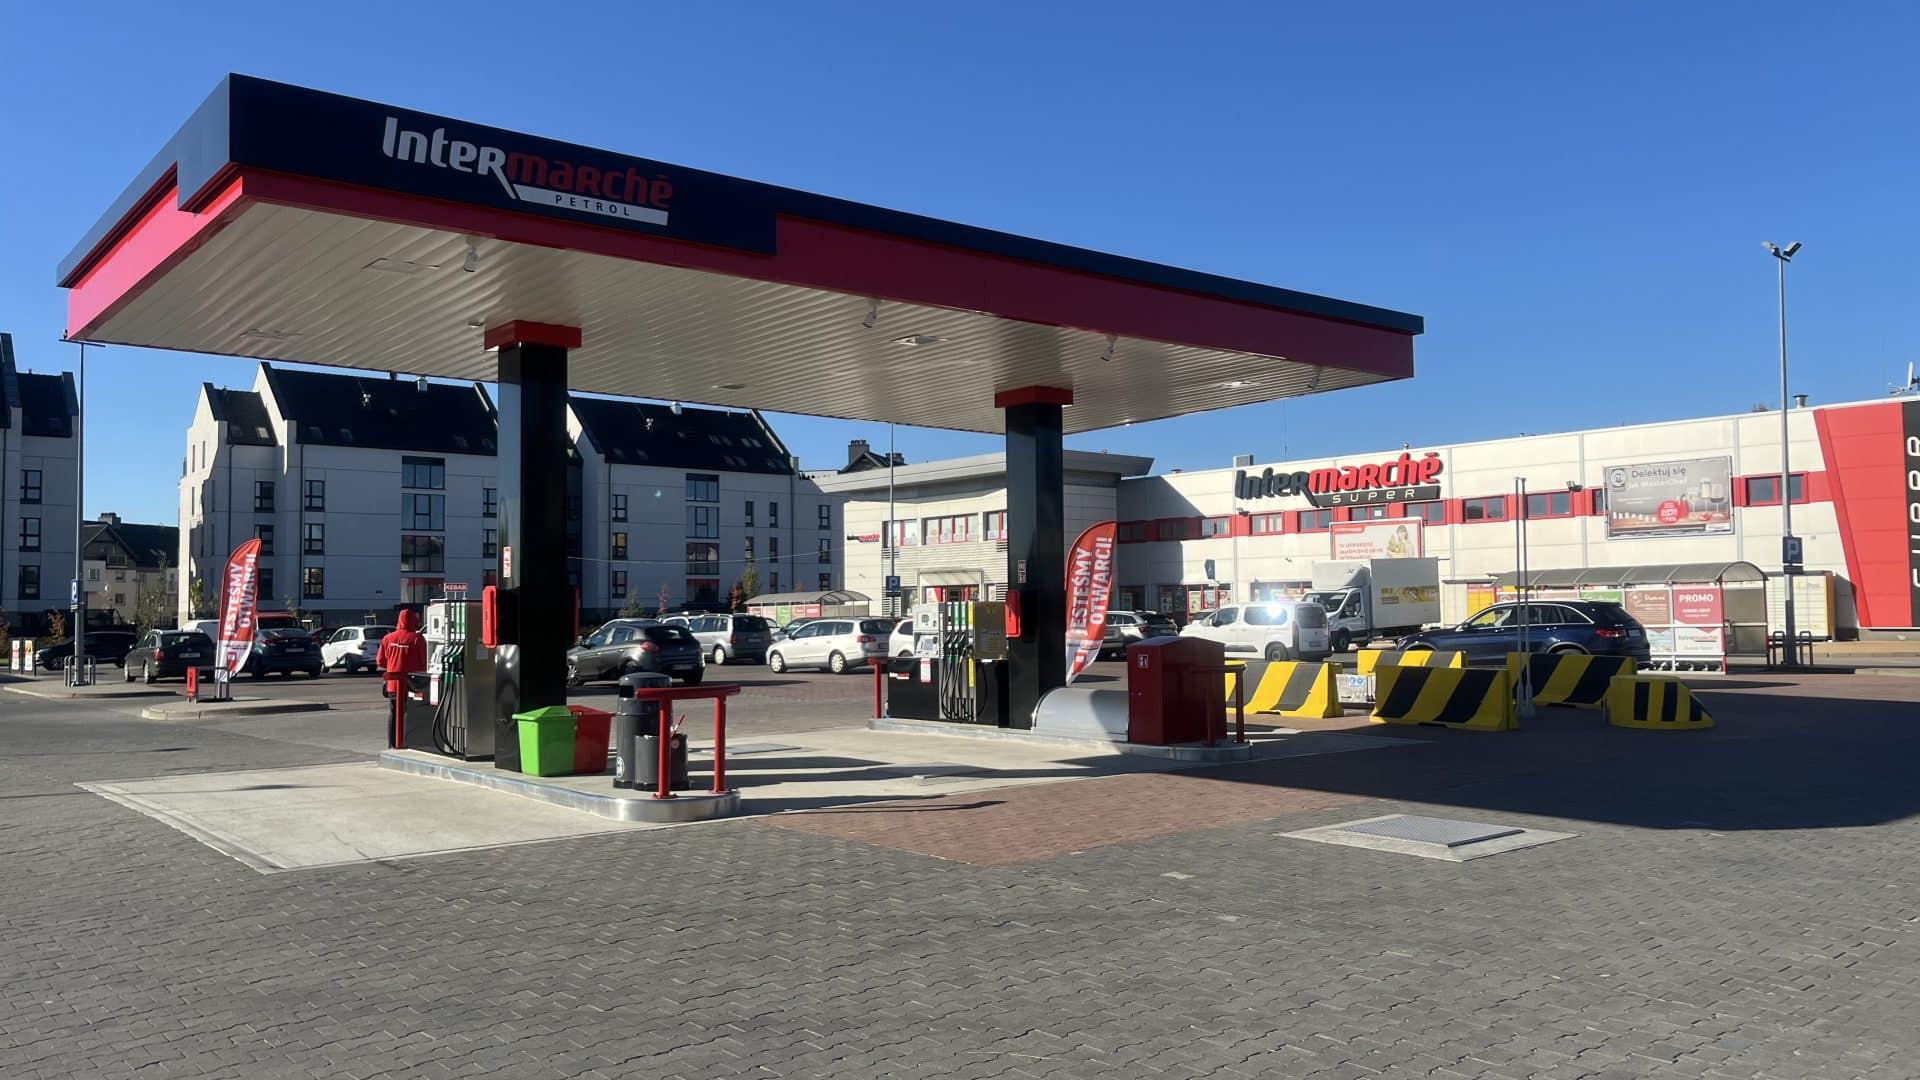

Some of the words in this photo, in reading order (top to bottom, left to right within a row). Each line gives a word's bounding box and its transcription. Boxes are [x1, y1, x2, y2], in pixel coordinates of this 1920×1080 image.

[555, 194, 630, 217] PETROL
[1631, 468, 1671, 479] Delektuj
[1332, 488, 1415, 505] SUPER
[1787, 539, 1799, 560] P
[889, 577, 898, 589] P
[1071, 546, 1092, 636] JESTEŚMY
[1090, 537, 1112, 625] OTWARCI!
[223, 562, 243, 638] JESTEŚMY
[1679, 594, 1713, 603] PROMO
